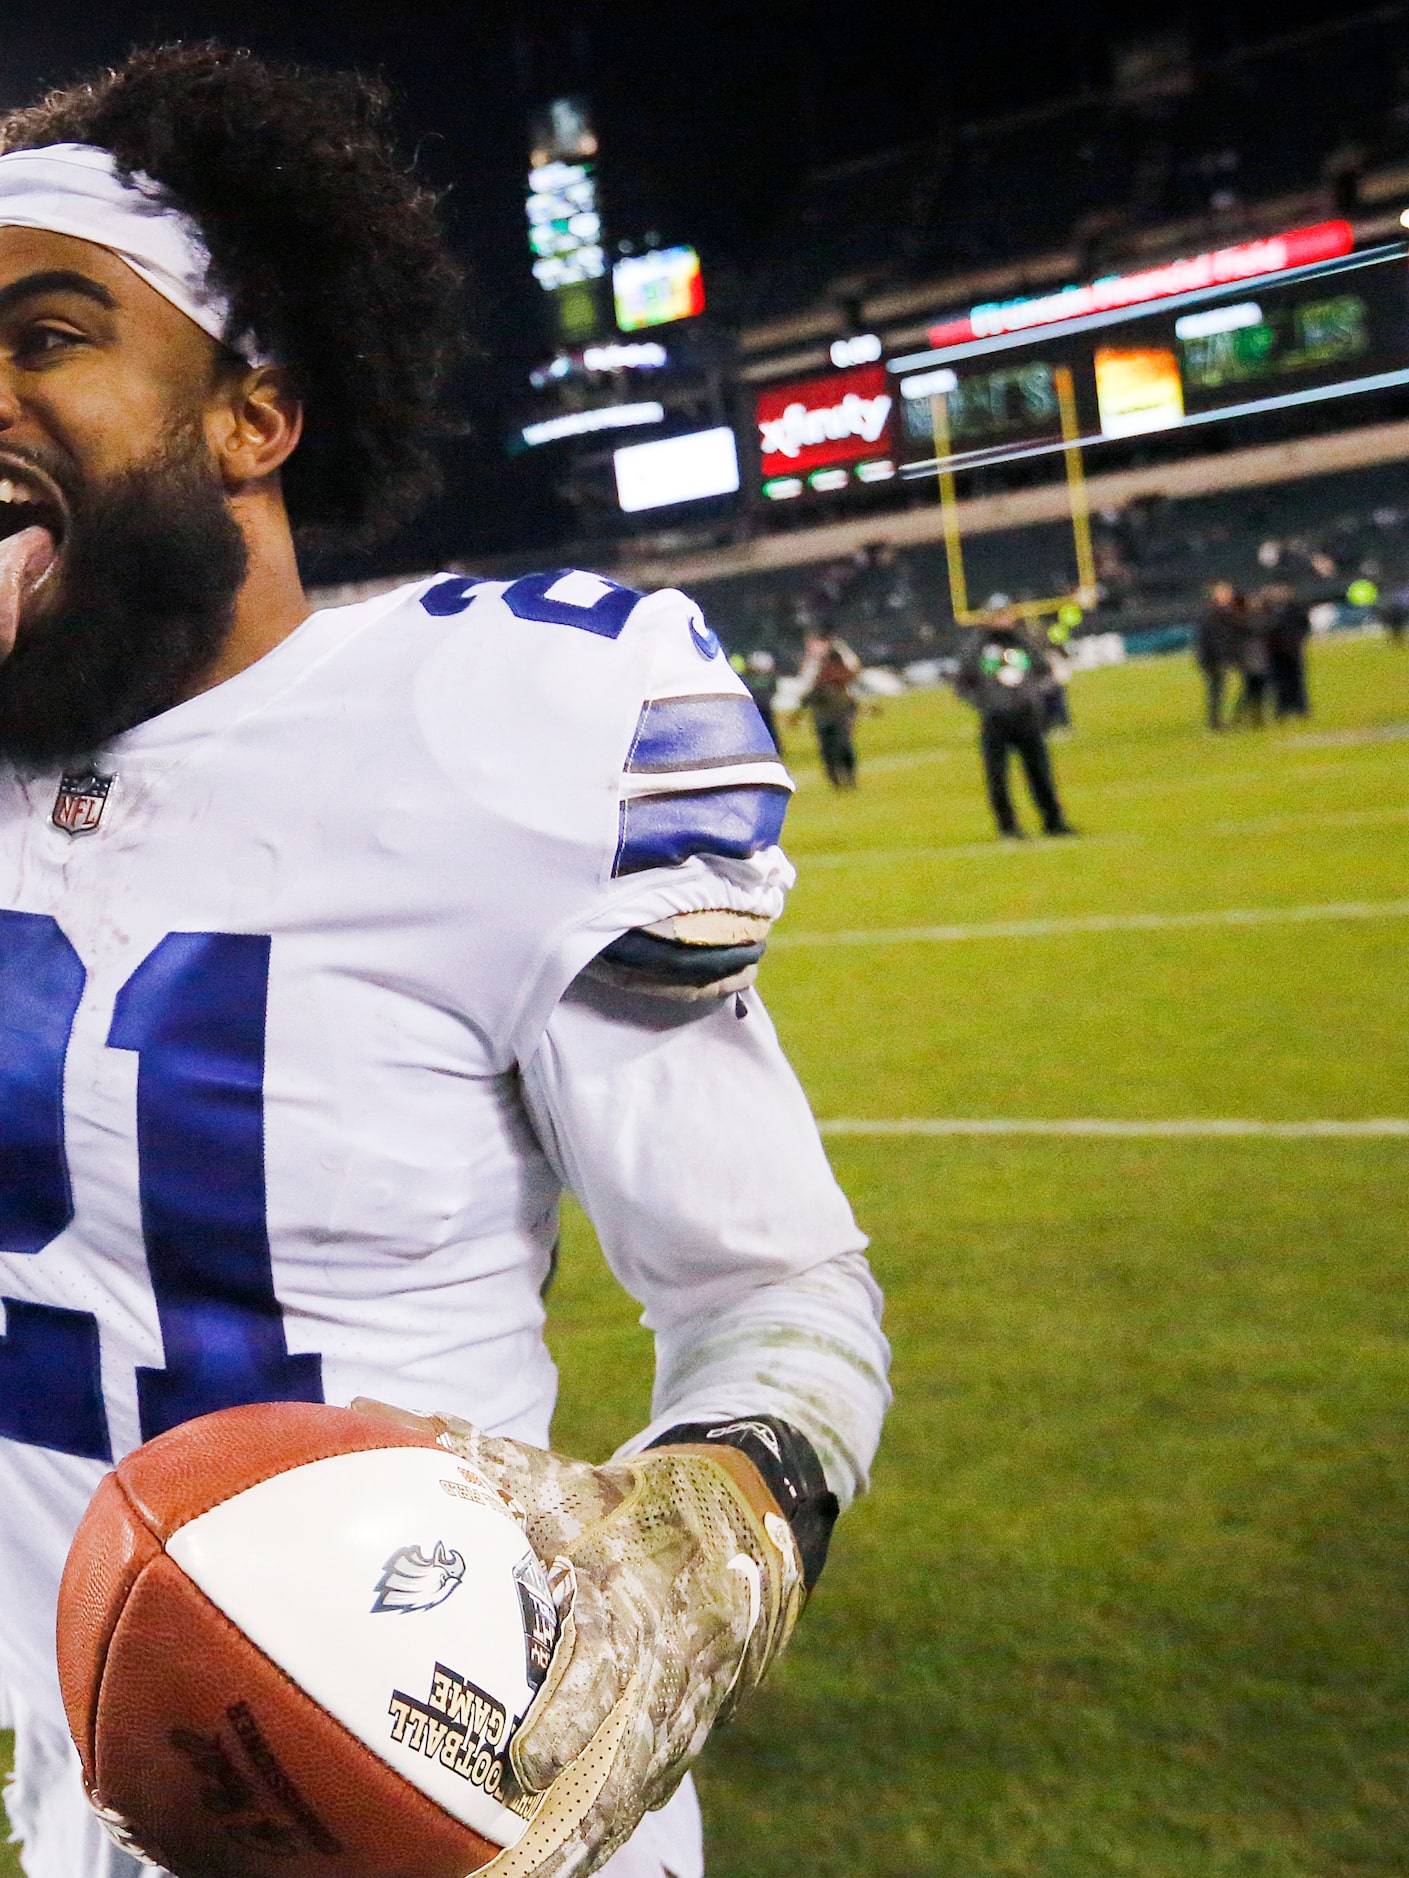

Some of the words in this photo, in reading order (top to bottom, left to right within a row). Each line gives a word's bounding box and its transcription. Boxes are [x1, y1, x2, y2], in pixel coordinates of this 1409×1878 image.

[758, 393, 891, 458] xfinity
[59, 795, 97, 827] NFL
[428, 1661, 507, 1747] GAME
[388, 1690, 504, 1804] OOTBALL
